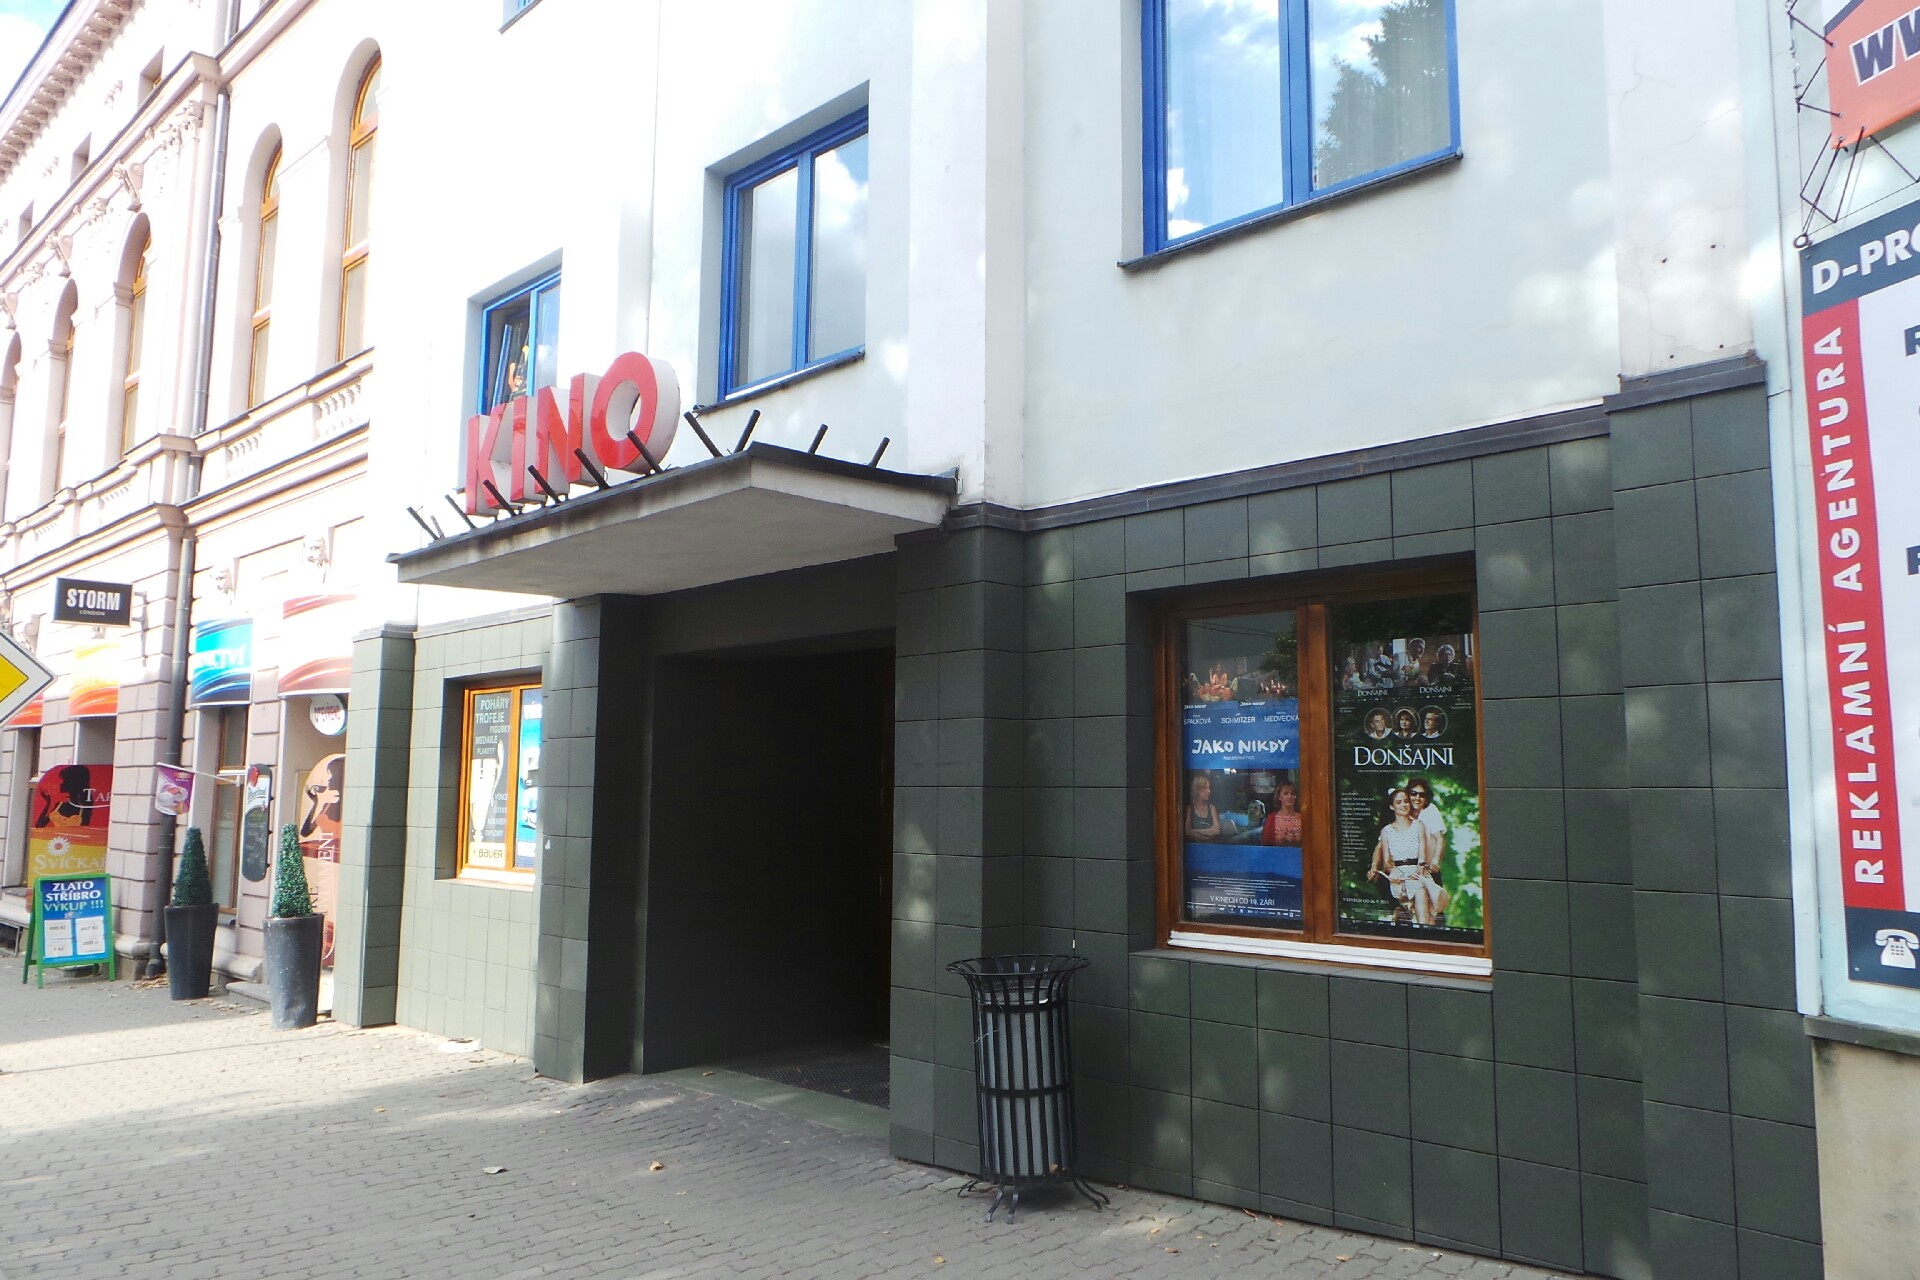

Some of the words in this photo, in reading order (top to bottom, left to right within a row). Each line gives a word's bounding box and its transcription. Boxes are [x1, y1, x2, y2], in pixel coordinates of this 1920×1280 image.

[465, 351, 670, 515] KINO
[1814, 327, 1862, 591] AGENTURA
[66, 588, 120, 611] STORM
[481, 696, 509, 710] POHÁRY
[475, 712, 505, 724] TROFEJE
[1192, 739, 1234, 754] JAKO
[1238, 739, 1290, 754] NIKDY
[1828, 621, 1885, 884] REKLAMNÍ
[1354, 744, 1454, 769] DONŠAJNI
[52, 881, 94, 892] ZLATO
[46, 890, 101, 902] STŘÍBRO
[44, 901, 87, 912] VÝKUP
[91, 899, 104, 909] !!!
